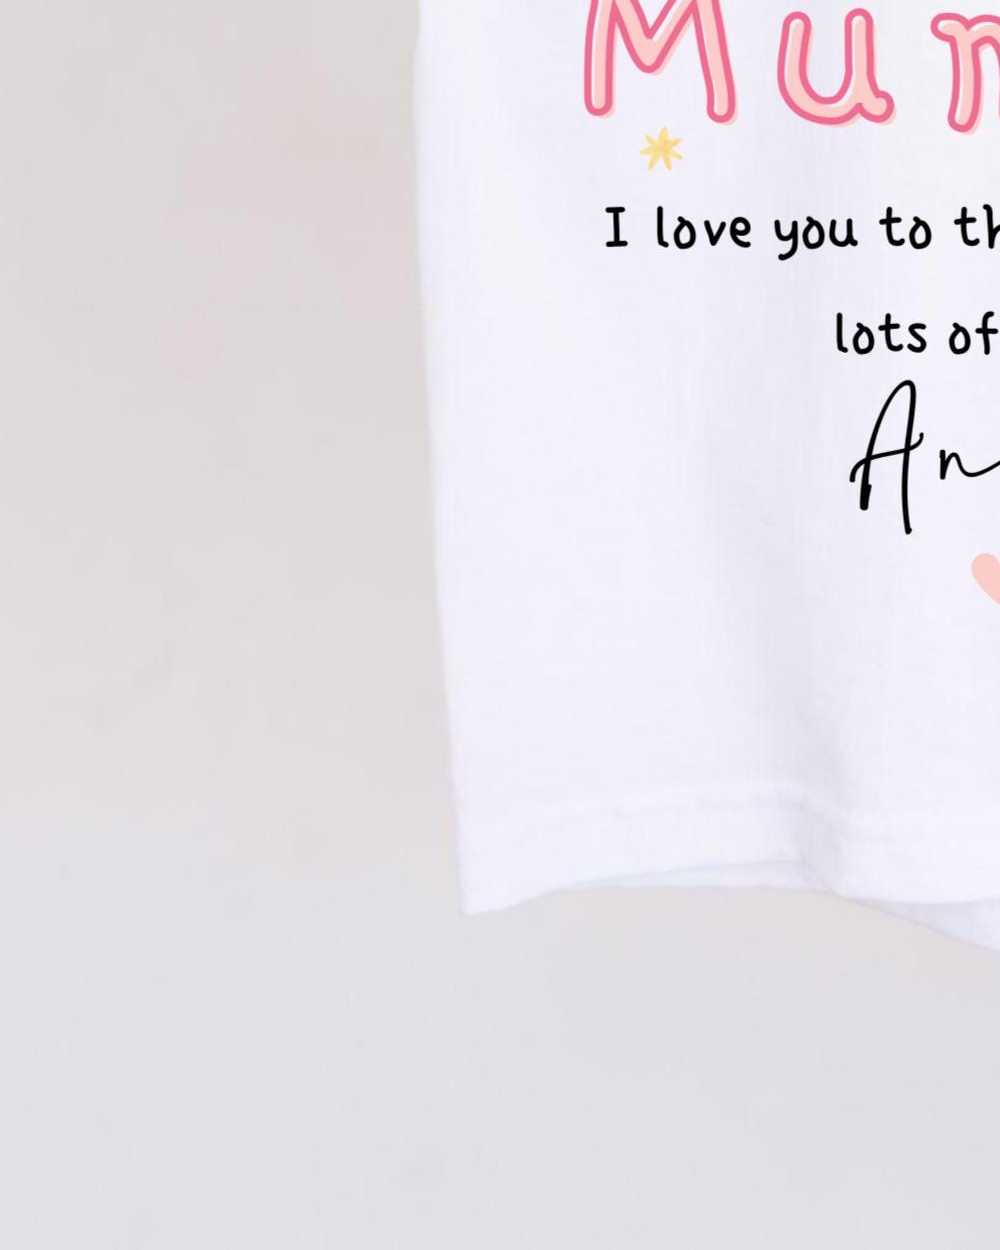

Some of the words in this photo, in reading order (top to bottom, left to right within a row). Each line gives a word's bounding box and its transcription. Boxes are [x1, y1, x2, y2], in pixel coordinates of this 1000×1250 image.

[604, 206, 629, 248] I
[656, 205, 752, 250] love
[773, 215, 859, 262] you
[878, 206, 933, 250] to
[835, 311, 928, 356] lots
[948, 310, 1000, 356] of
